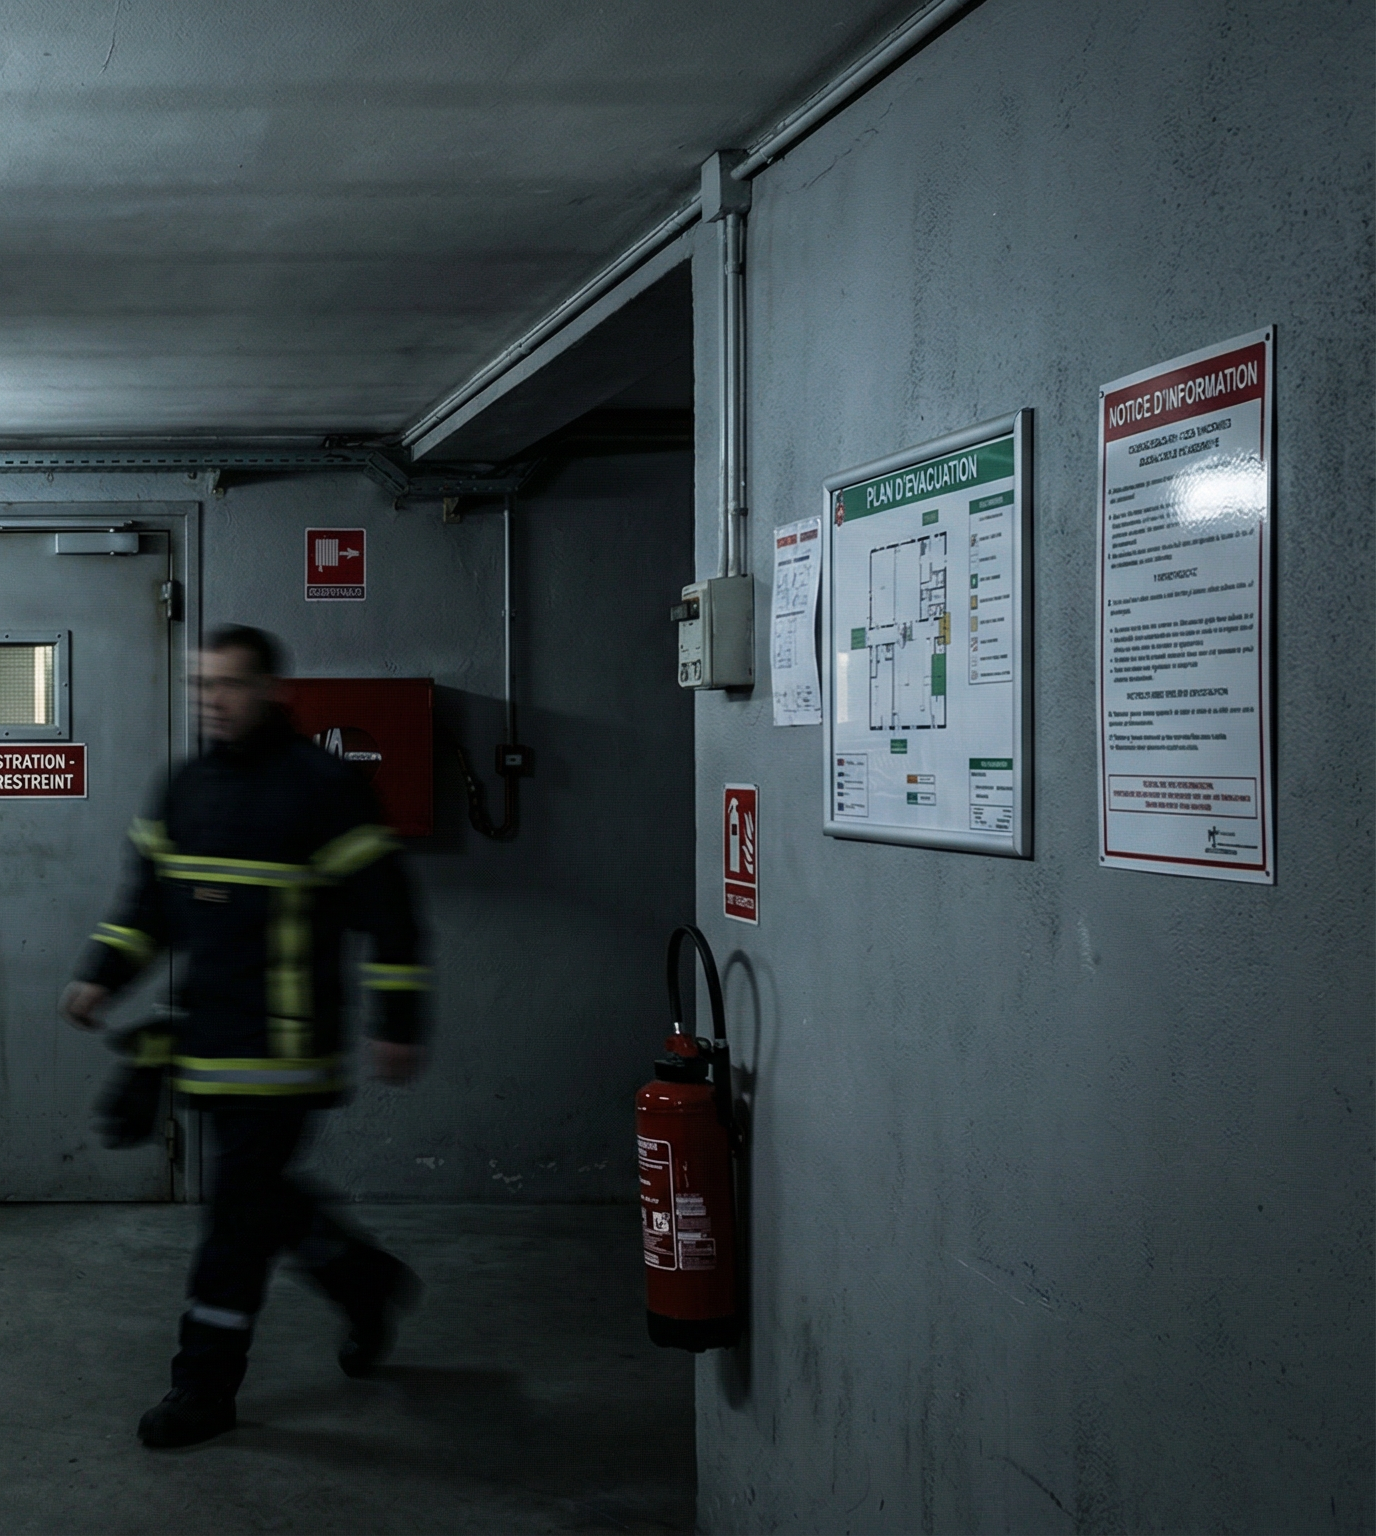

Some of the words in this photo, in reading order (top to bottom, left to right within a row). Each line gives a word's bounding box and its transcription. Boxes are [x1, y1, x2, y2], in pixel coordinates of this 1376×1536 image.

[1109, 394, 1151, 429] NOTICE
[1154, 360, 1258, 415] D'INFORMATION
[866, 480, 893, 509] PLAN
